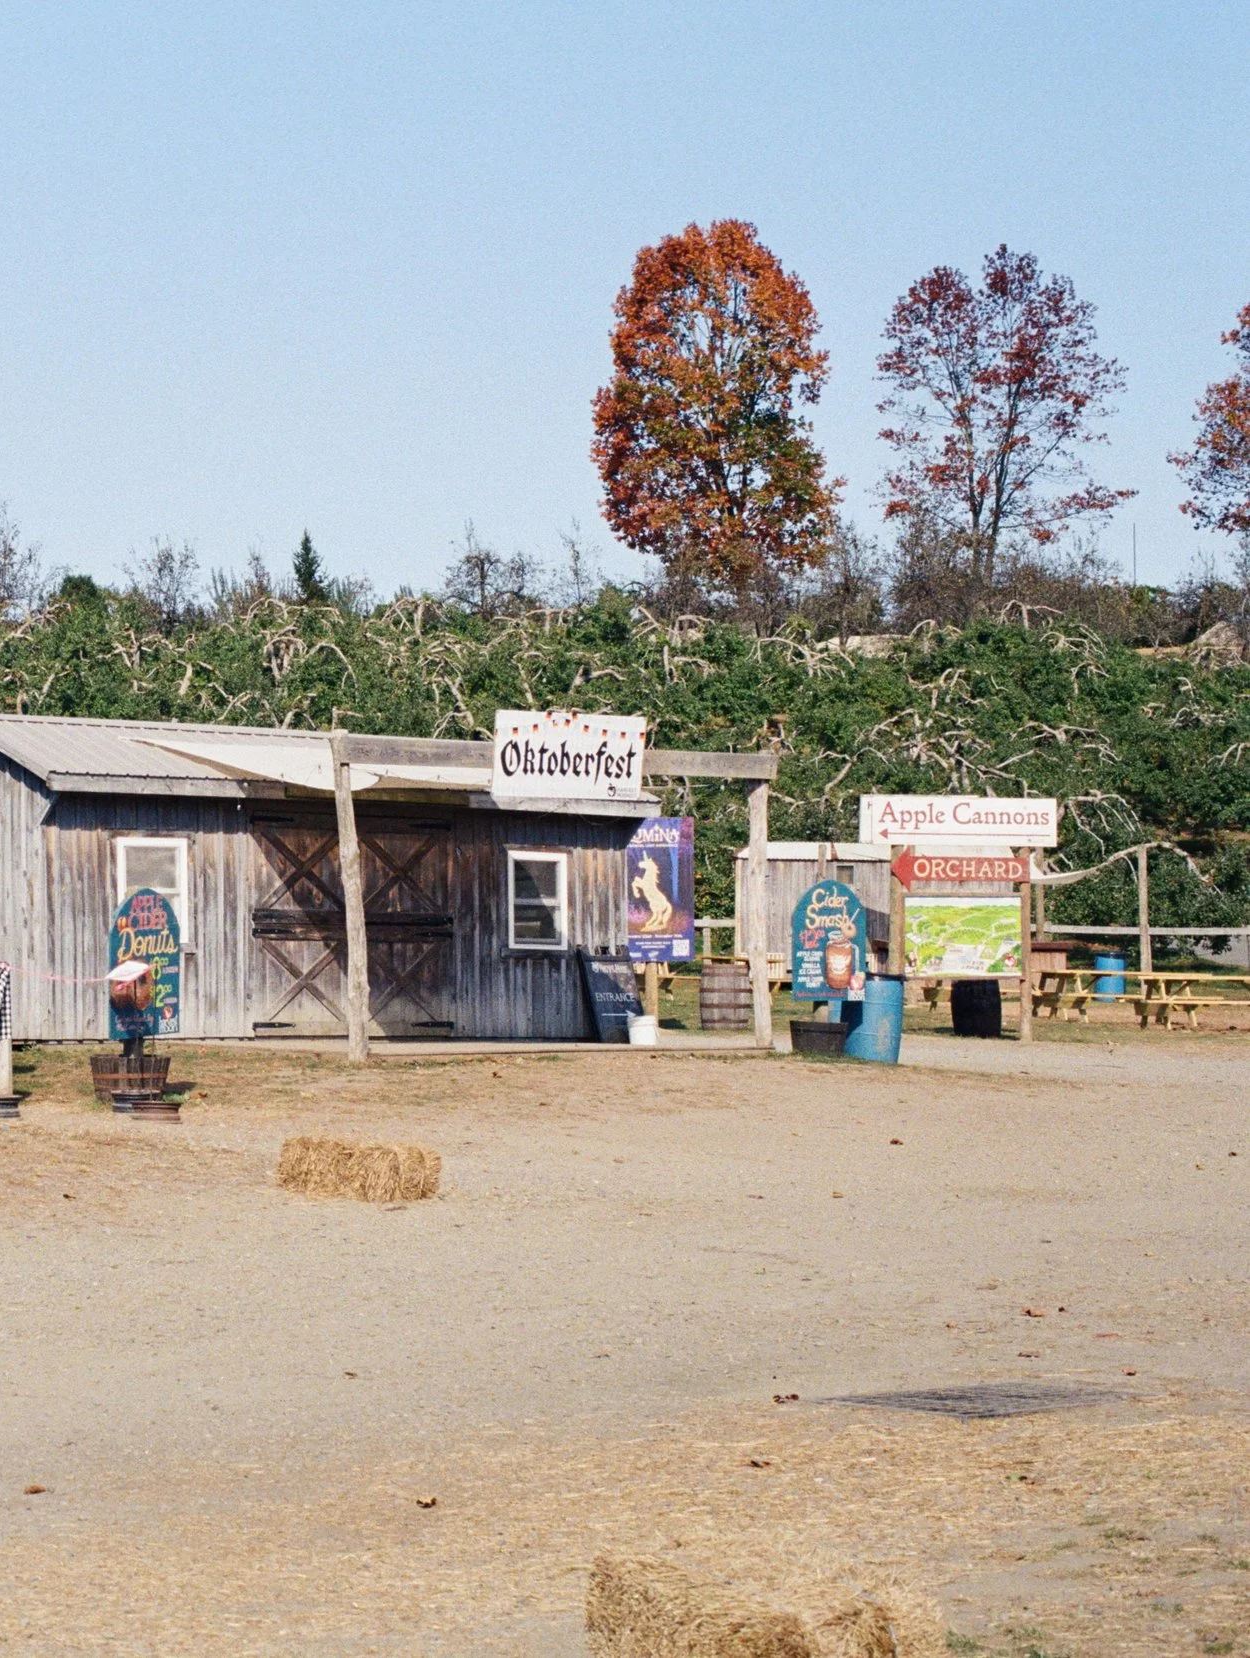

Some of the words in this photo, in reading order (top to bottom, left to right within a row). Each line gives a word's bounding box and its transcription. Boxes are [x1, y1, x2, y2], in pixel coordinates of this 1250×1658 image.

[500, 739, 637, 786] Oktoberfest
[878, 801, 946, 830] Apple
[952, 802, 1050, 826] Cannons
[913, 858, 1023, 880] ORCHARD
[130, 893, 163, 913] APPLE
[812, 886, 849, 908] Cider
[128, 909, 168, 931] CIDER
[805, 904, 849, 929] Smash
[117, 926, 179, 960] Donuts
[595, 992, 636, 1002] ENTRANCE
